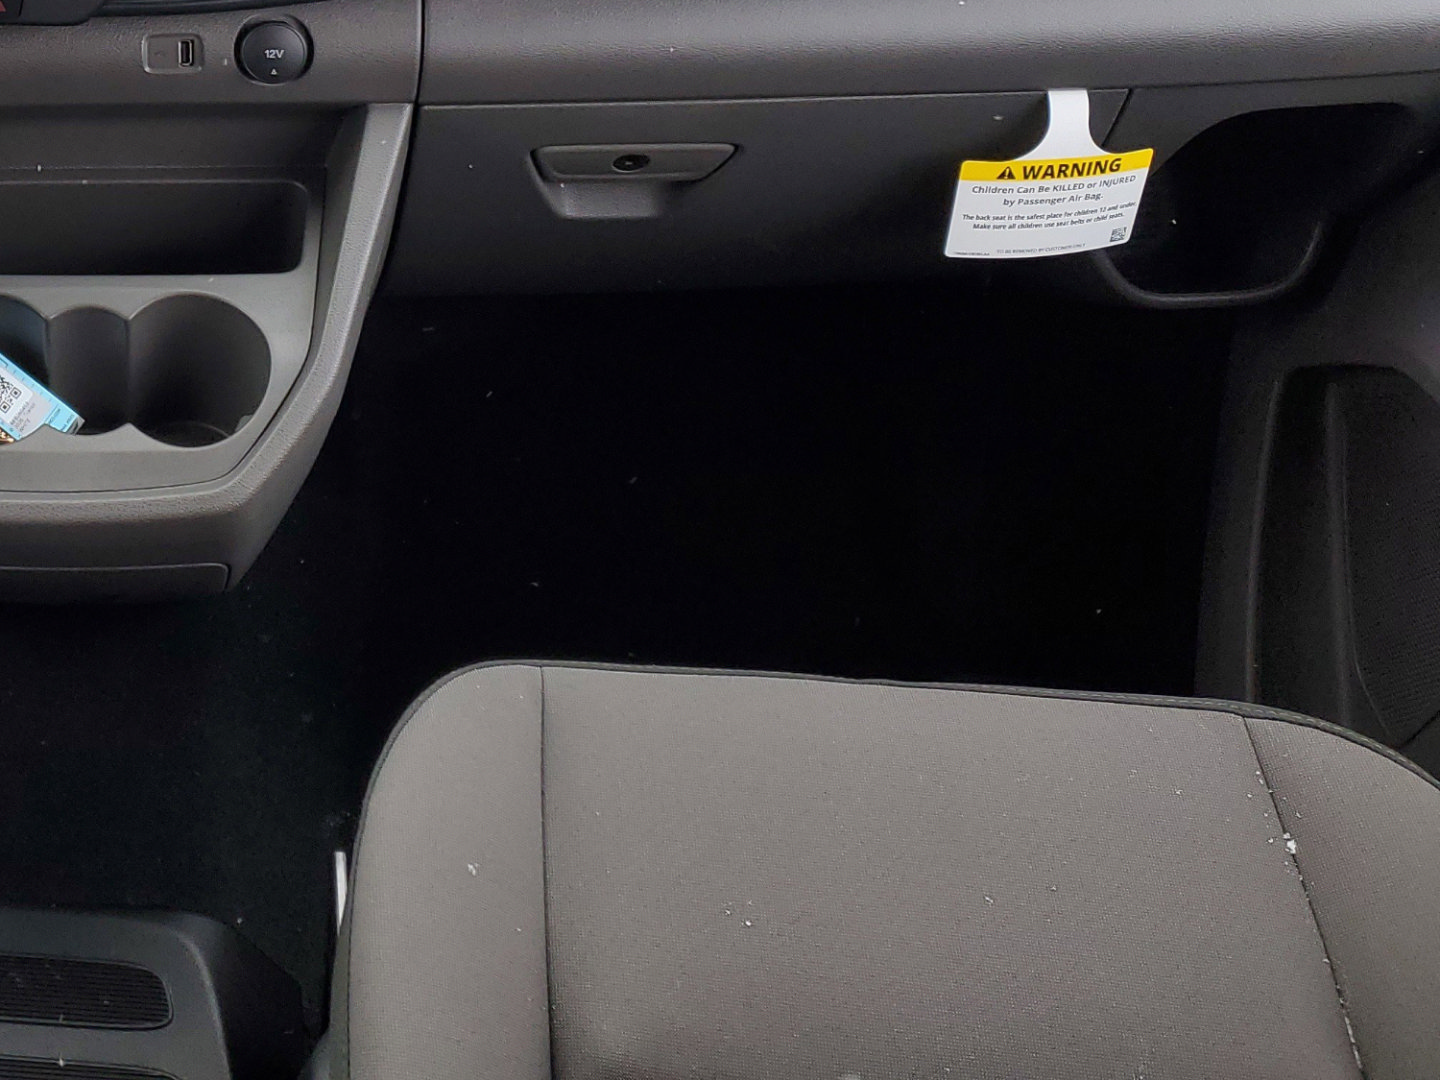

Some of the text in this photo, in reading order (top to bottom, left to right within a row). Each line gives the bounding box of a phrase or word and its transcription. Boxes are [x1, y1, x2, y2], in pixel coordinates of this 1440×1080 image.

[264, 49, 285, 60] 12V
[1021, 158, 1122, 180] WARNING
[972, 175, 1137, 194] Children Can Be KILLED or INJURED
[1003, 192, 1104, 207] by Passenger Air Bag.
[962, 213, 975, 221] The
[975, 213, 991, 221] back
[992, 213, 1006, 221] seat
[1007, 213, 1013, 221] is
[1013, 213, 1026, 221] the
[1026, 212, 1046, 221] safest
[1046, 212, 1063, 221] place
[1064, 211, 1073, 219] for
[1073, 208, 1098, 217] children
[1107, 204, 1119, 212] and
[972, 222, 992, 231] Make
[1008, 222, 1017, 230] all
[1017, 222, 1043, 230] children
[1070, 218, 1086, 227] belts
[1094, 215, 1108, 224] child
